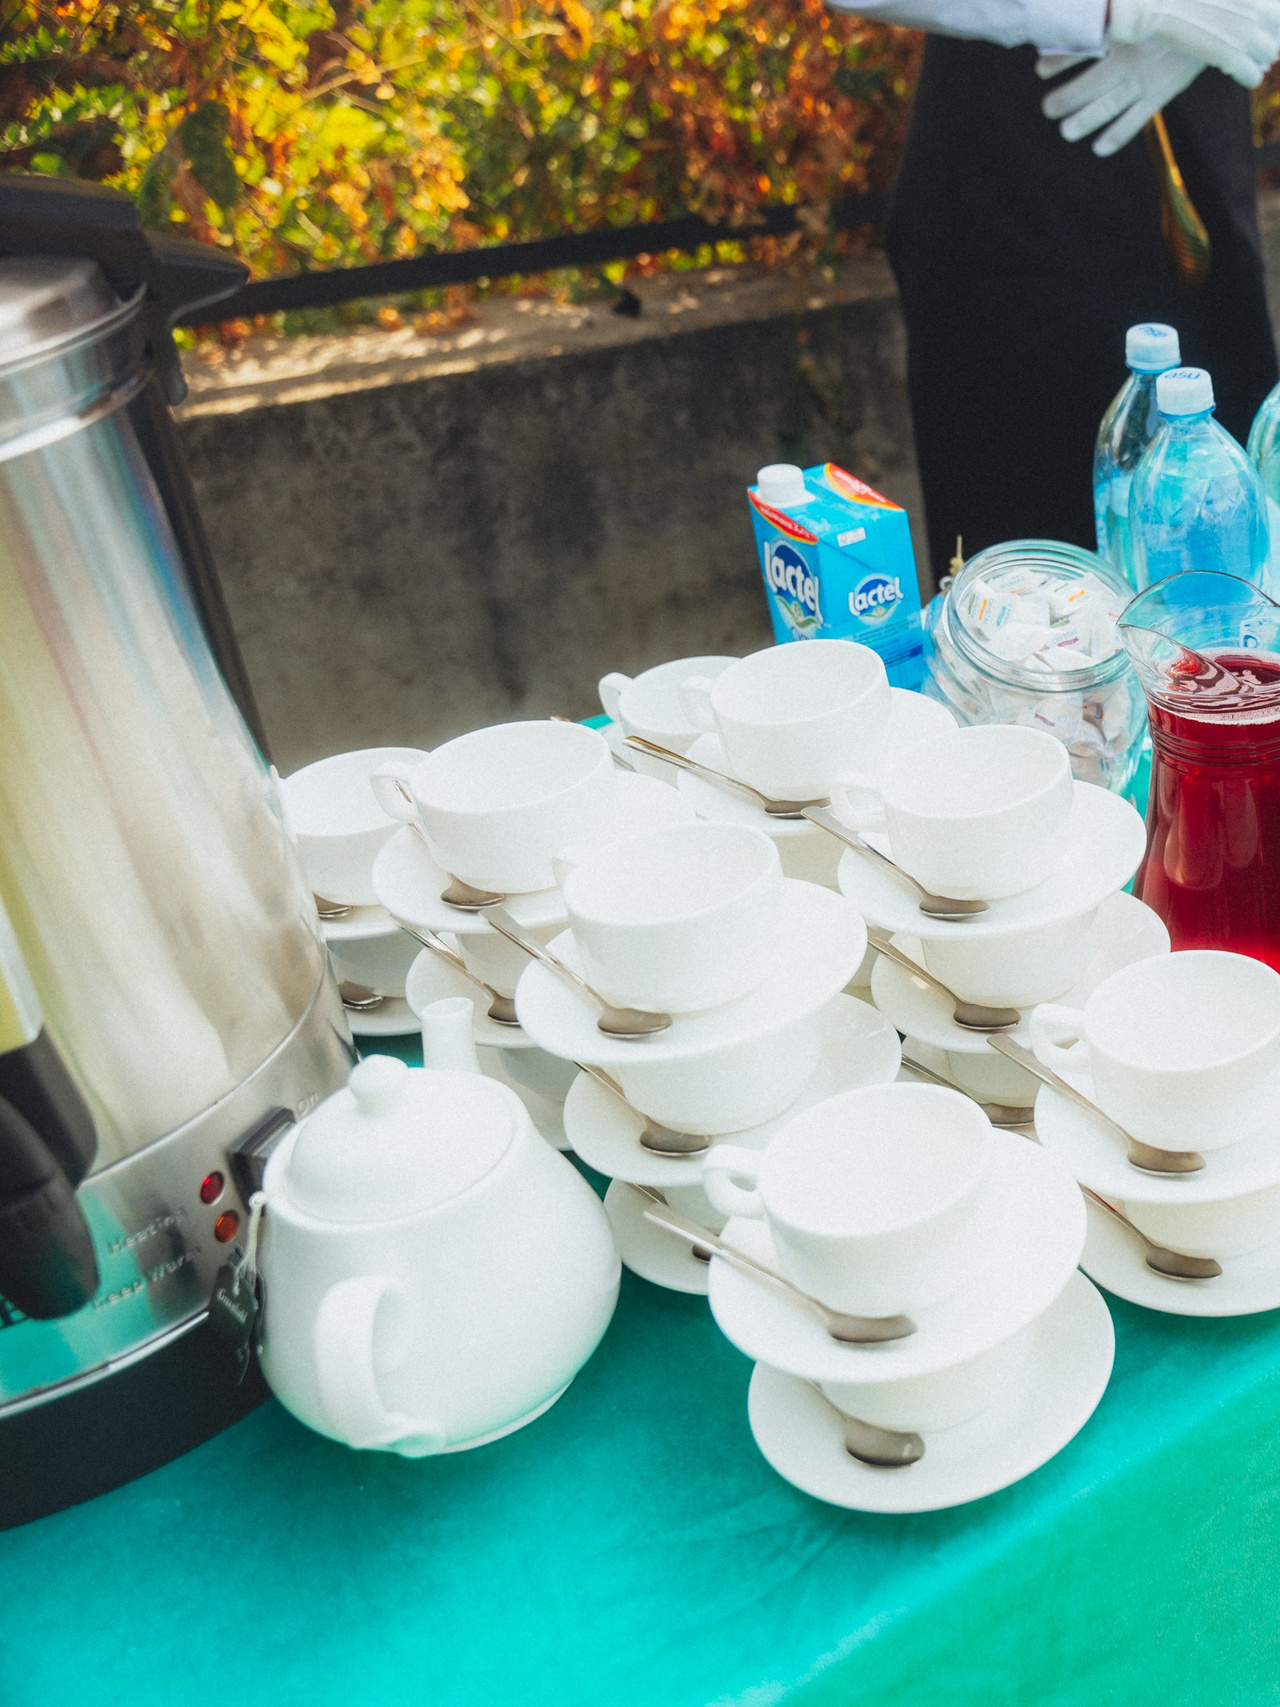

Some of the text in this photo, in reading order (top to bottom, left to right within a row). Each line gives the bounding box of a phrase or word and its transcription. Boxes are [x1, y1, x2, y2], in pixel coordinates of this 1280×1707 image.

[764, 541, 824, 624] lactel
[847, 576, 904, 617] lactel
[108, 1207, 186, 1254] Heating
[93, 1278, 147, 1311] Keep
